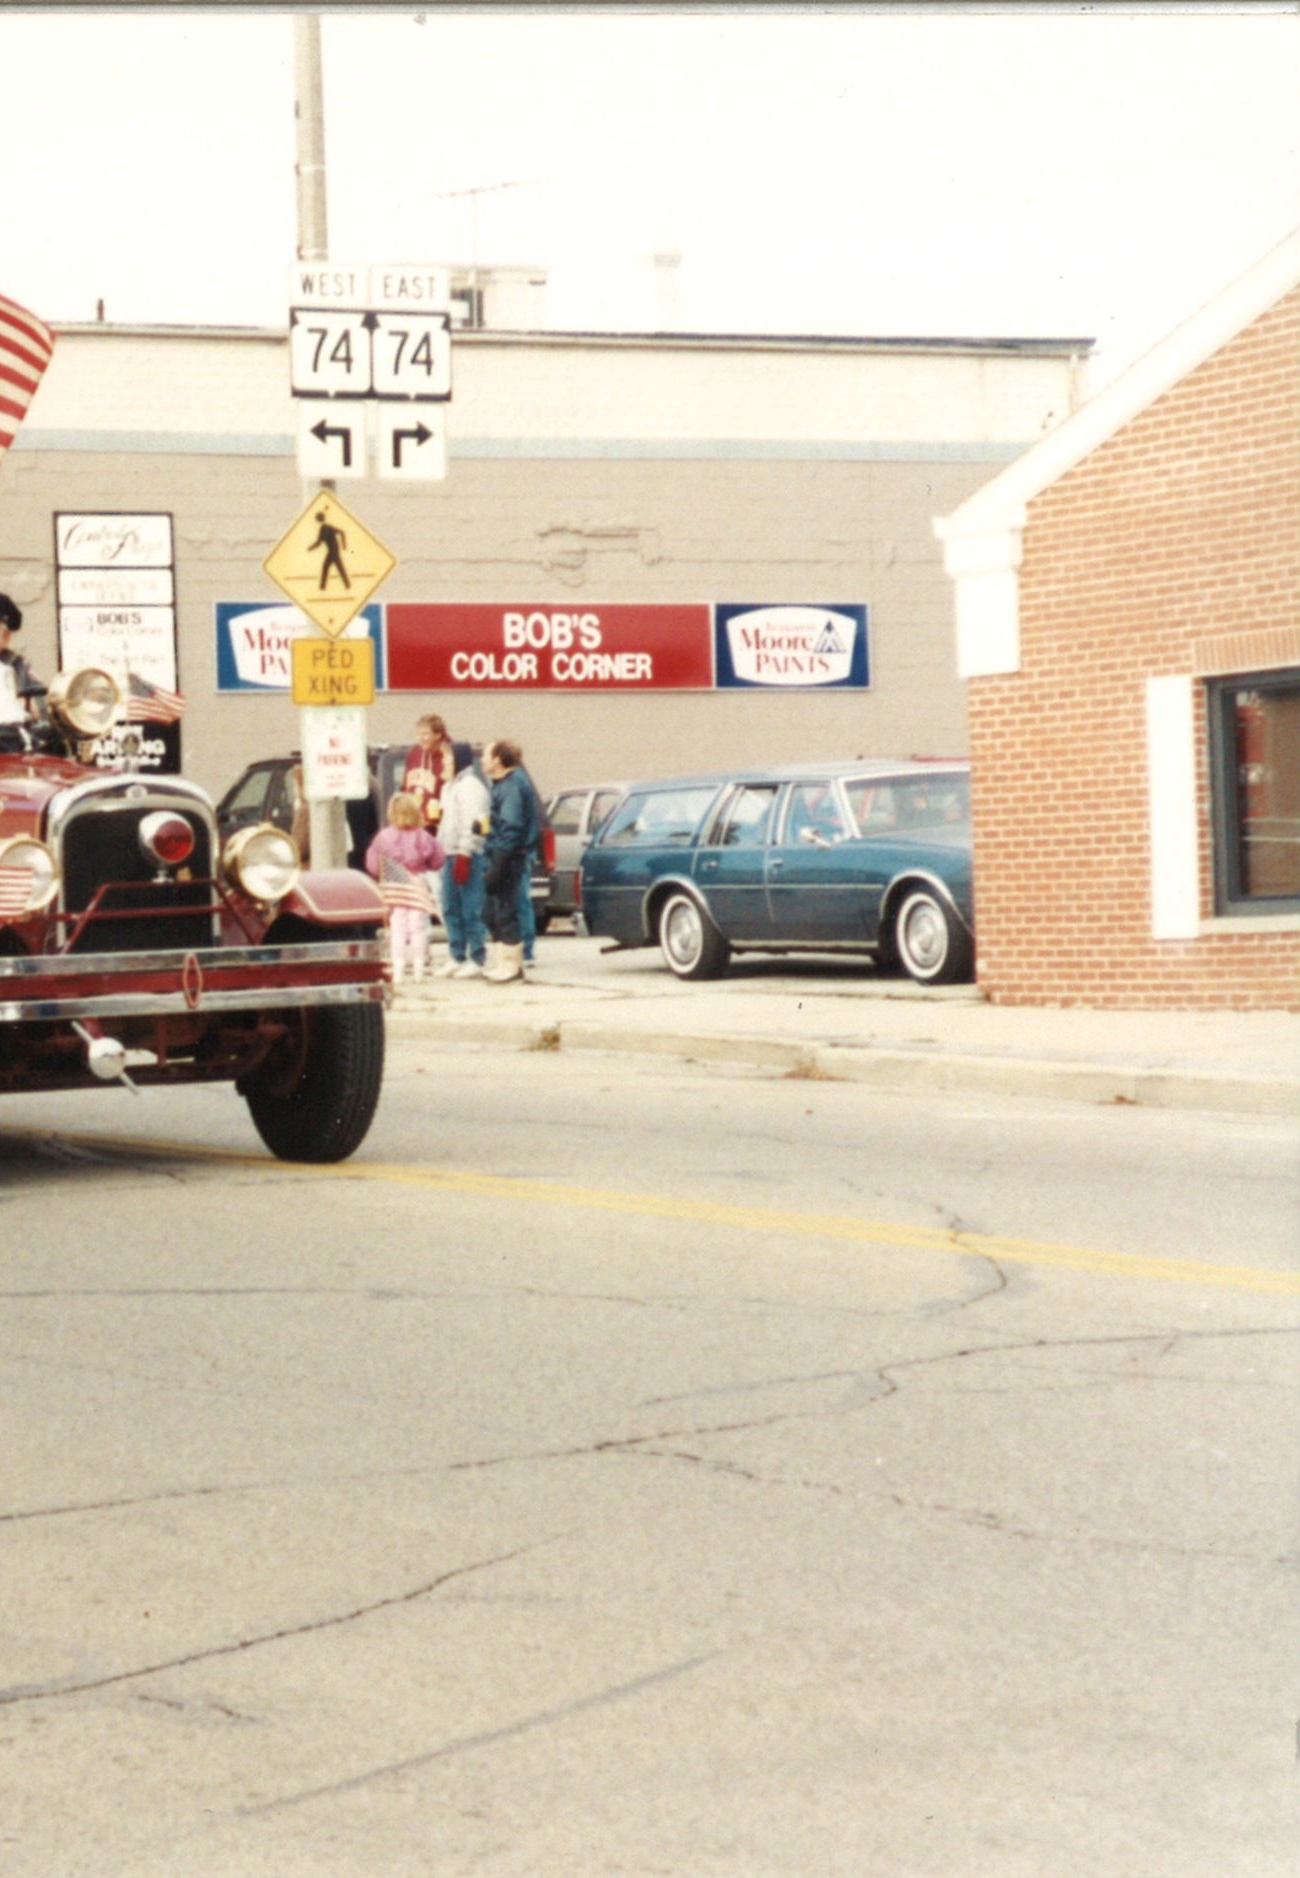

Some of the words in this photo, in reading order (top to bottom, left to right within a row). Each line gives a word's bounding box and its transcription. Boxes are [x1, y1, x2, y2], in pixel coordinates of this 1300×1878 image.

[301, 273, 355, 297] WEST
[384, 276, 435, 300] EAST
[307, 328, 354, 374] 74
[388, 331, 434, 376] 74
[503, 612, 602, 650] BOB'S
[741, 628, 814, 651] Moore
[312, 649, 354, 669] PED
[451, 652, 538, 681] COLOR
[551, 652, 653, 681] CORNER
[756, 653, 831, 674] PAINTS
[309, 675, 358, 695] XING
